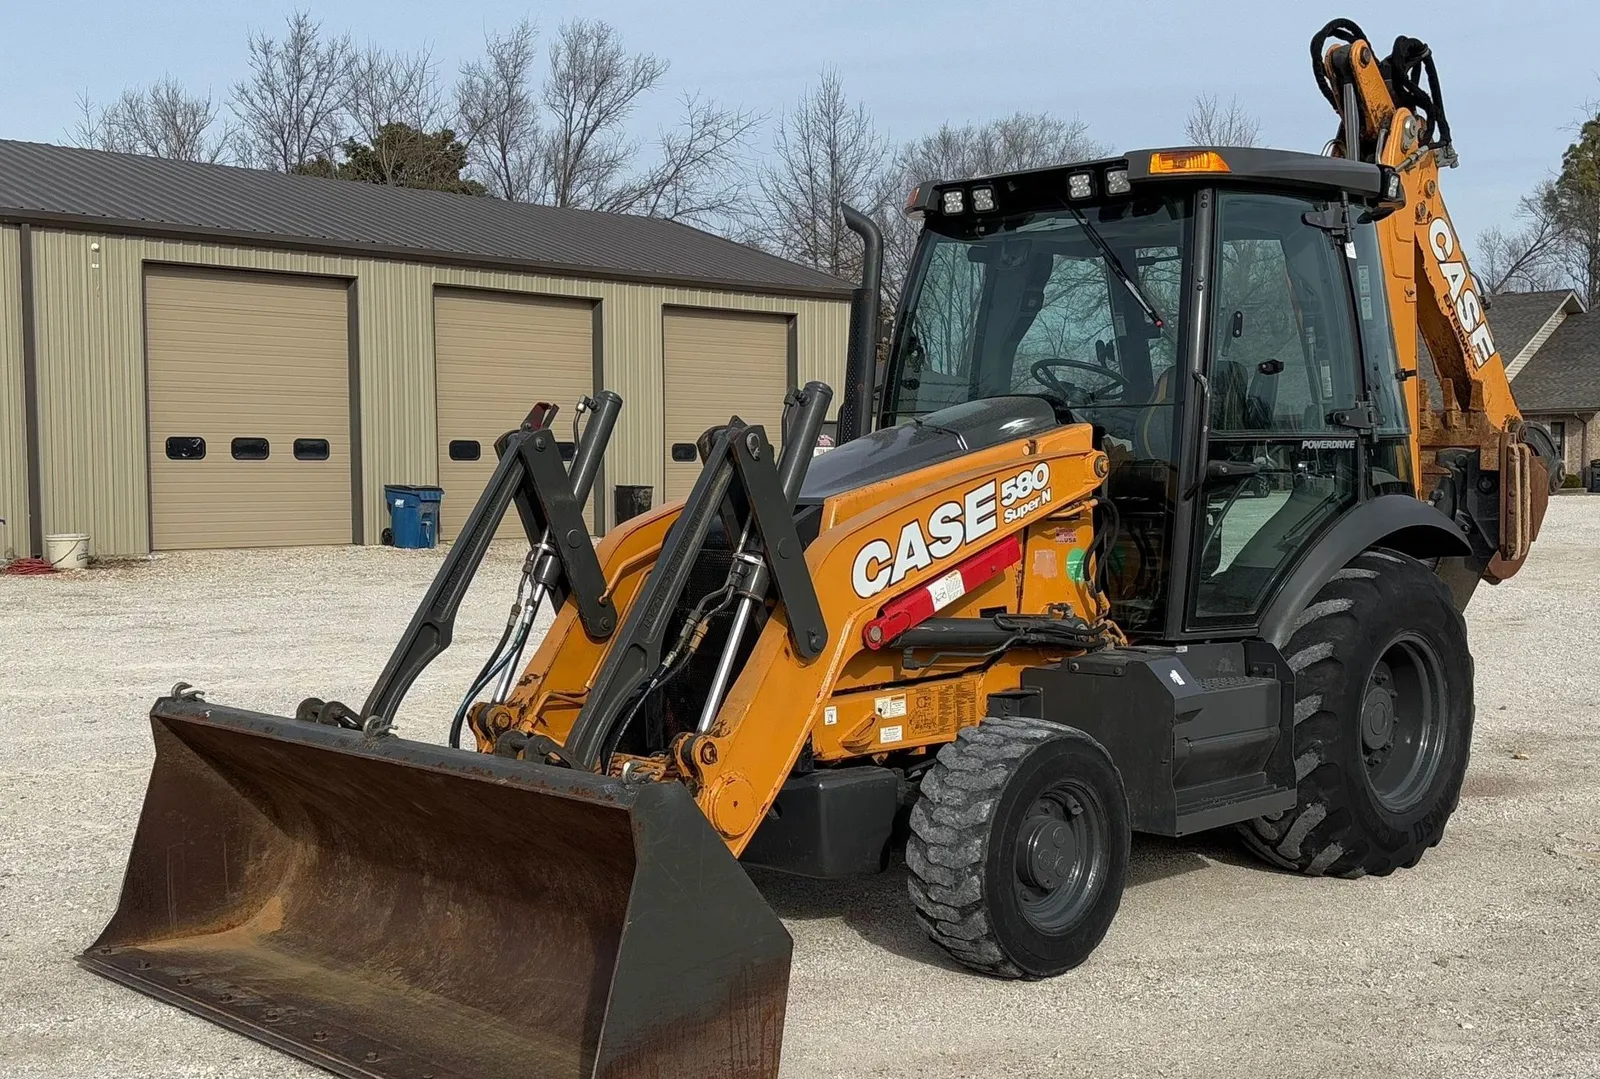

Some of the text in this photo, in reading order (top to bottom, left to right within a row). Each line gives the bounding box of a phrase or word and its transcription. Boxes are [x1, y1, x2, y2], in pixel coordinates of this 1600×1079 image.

[1428, 217, 1496, 369] CASE
[1301, 440, 1356, 450] POWERDRIVE
[1000, 461, 1050, 507] 580
[1003, 487, 1052, 524] Super N
[852, 478, 997, 599] CASE
